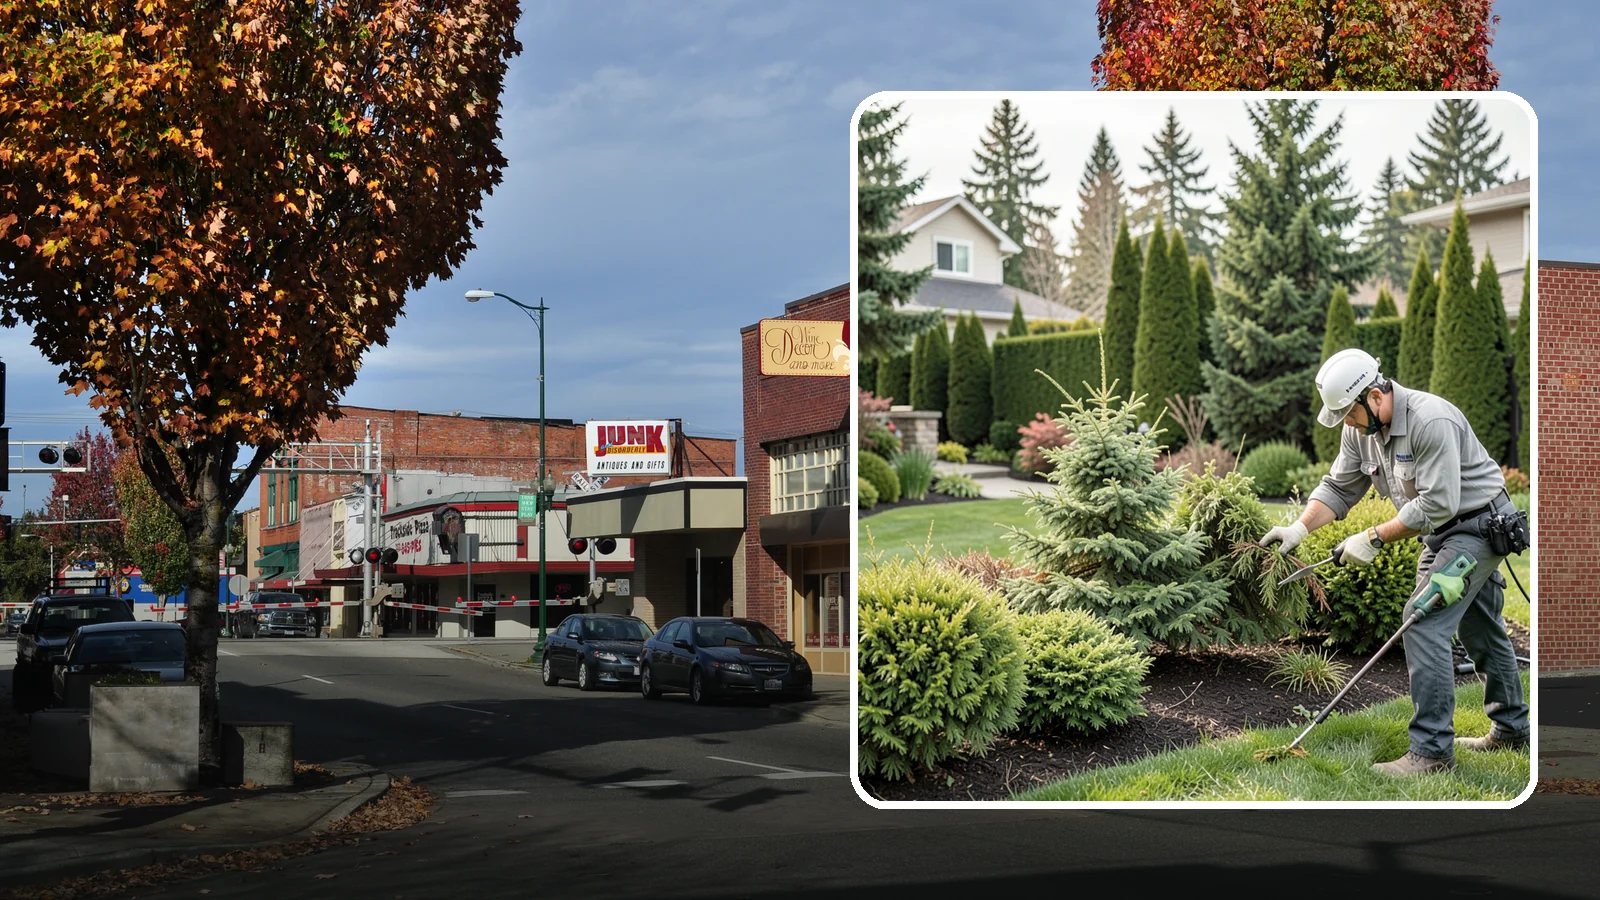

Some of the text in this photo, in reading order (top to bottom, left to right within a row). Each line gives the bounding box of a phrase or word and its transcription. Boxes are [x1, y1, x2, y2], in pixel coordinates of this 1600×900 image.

[595, 425, 665, 457] JUNK
[607, 446, 645, 454] DISORDERLY
[597, 460, 665, 470] ANTIQUES AND GIFTS
